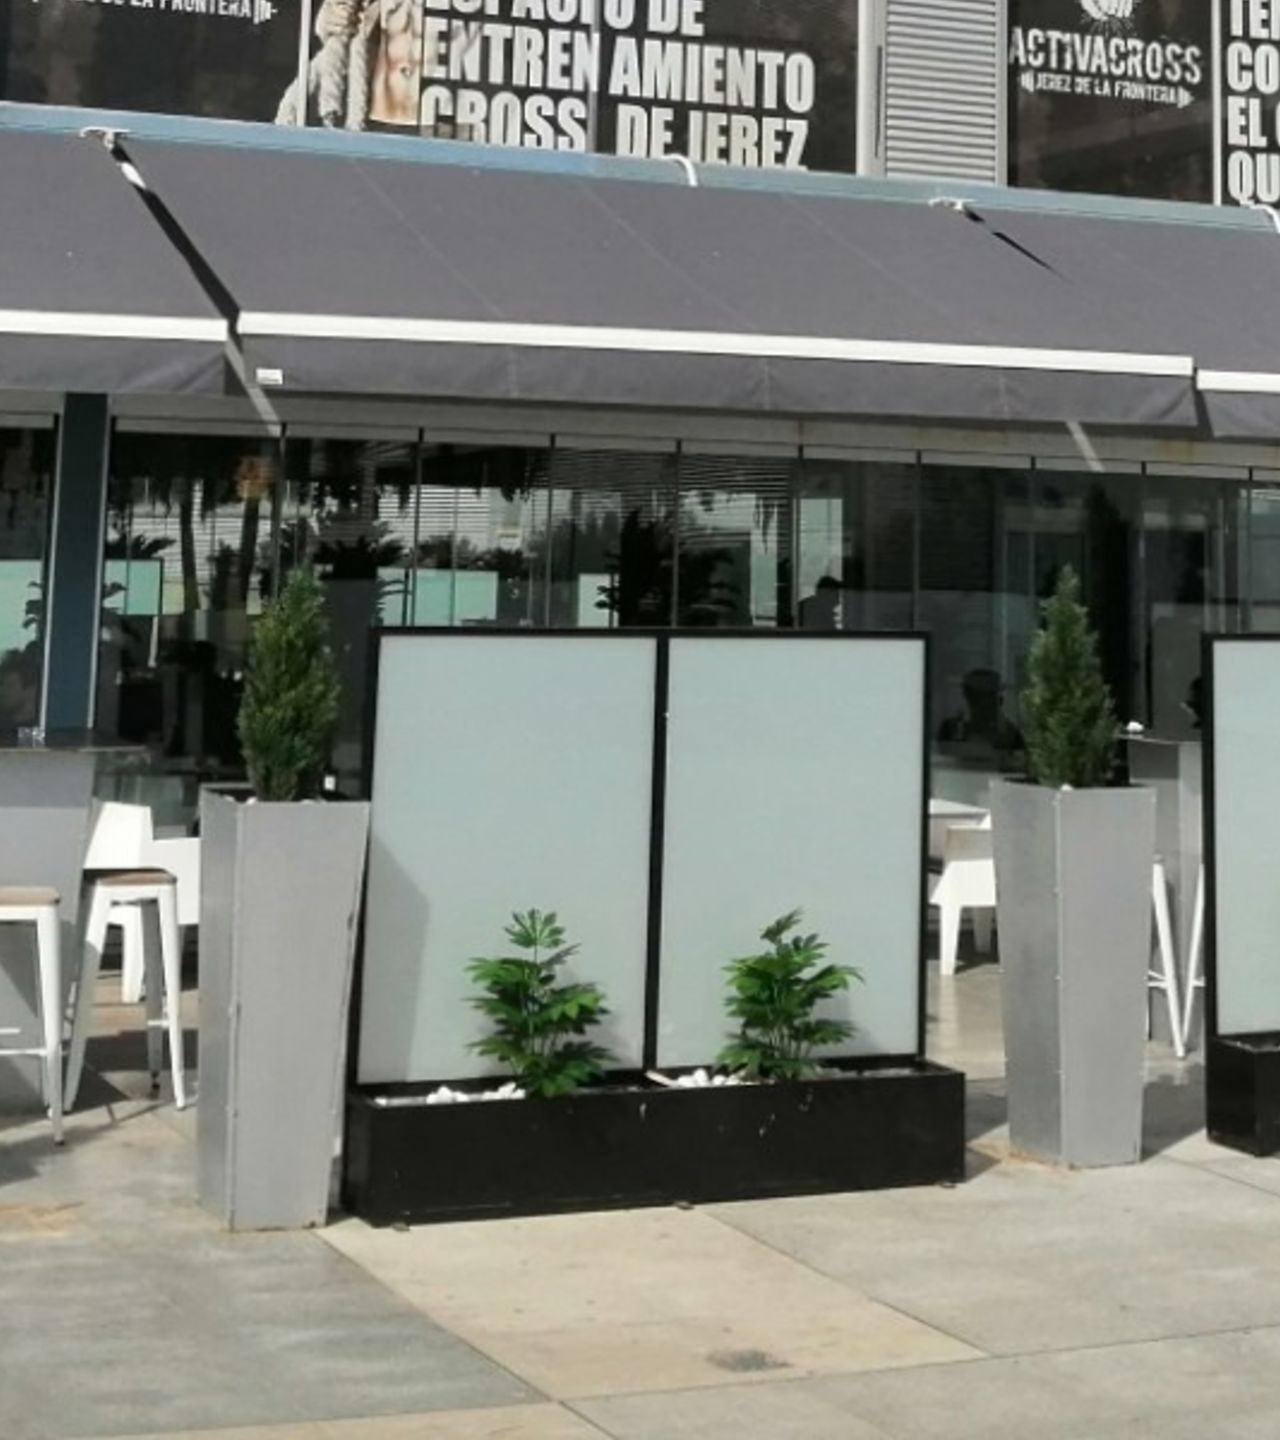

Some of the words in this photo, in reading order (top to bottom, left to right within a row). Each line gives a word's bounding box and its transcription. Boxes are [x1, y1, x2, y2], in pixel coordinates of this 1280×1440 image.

[423, 17, 816, 114] ENTRENAMIENTO
[1009, 26, 1202, 85] ACTIVACROSS
[1036, 72, 1071, 92] JEREZ
[1074, 77, 1092, 94] DE
[1094, 78, 1111, 97] LA
[1114, 80, 1177, 105] FRONTERA
[421, 85, 587, 152] CROSS
[616, 103, 674, 160] DE
[1227, 96, 1268, 148] EL
